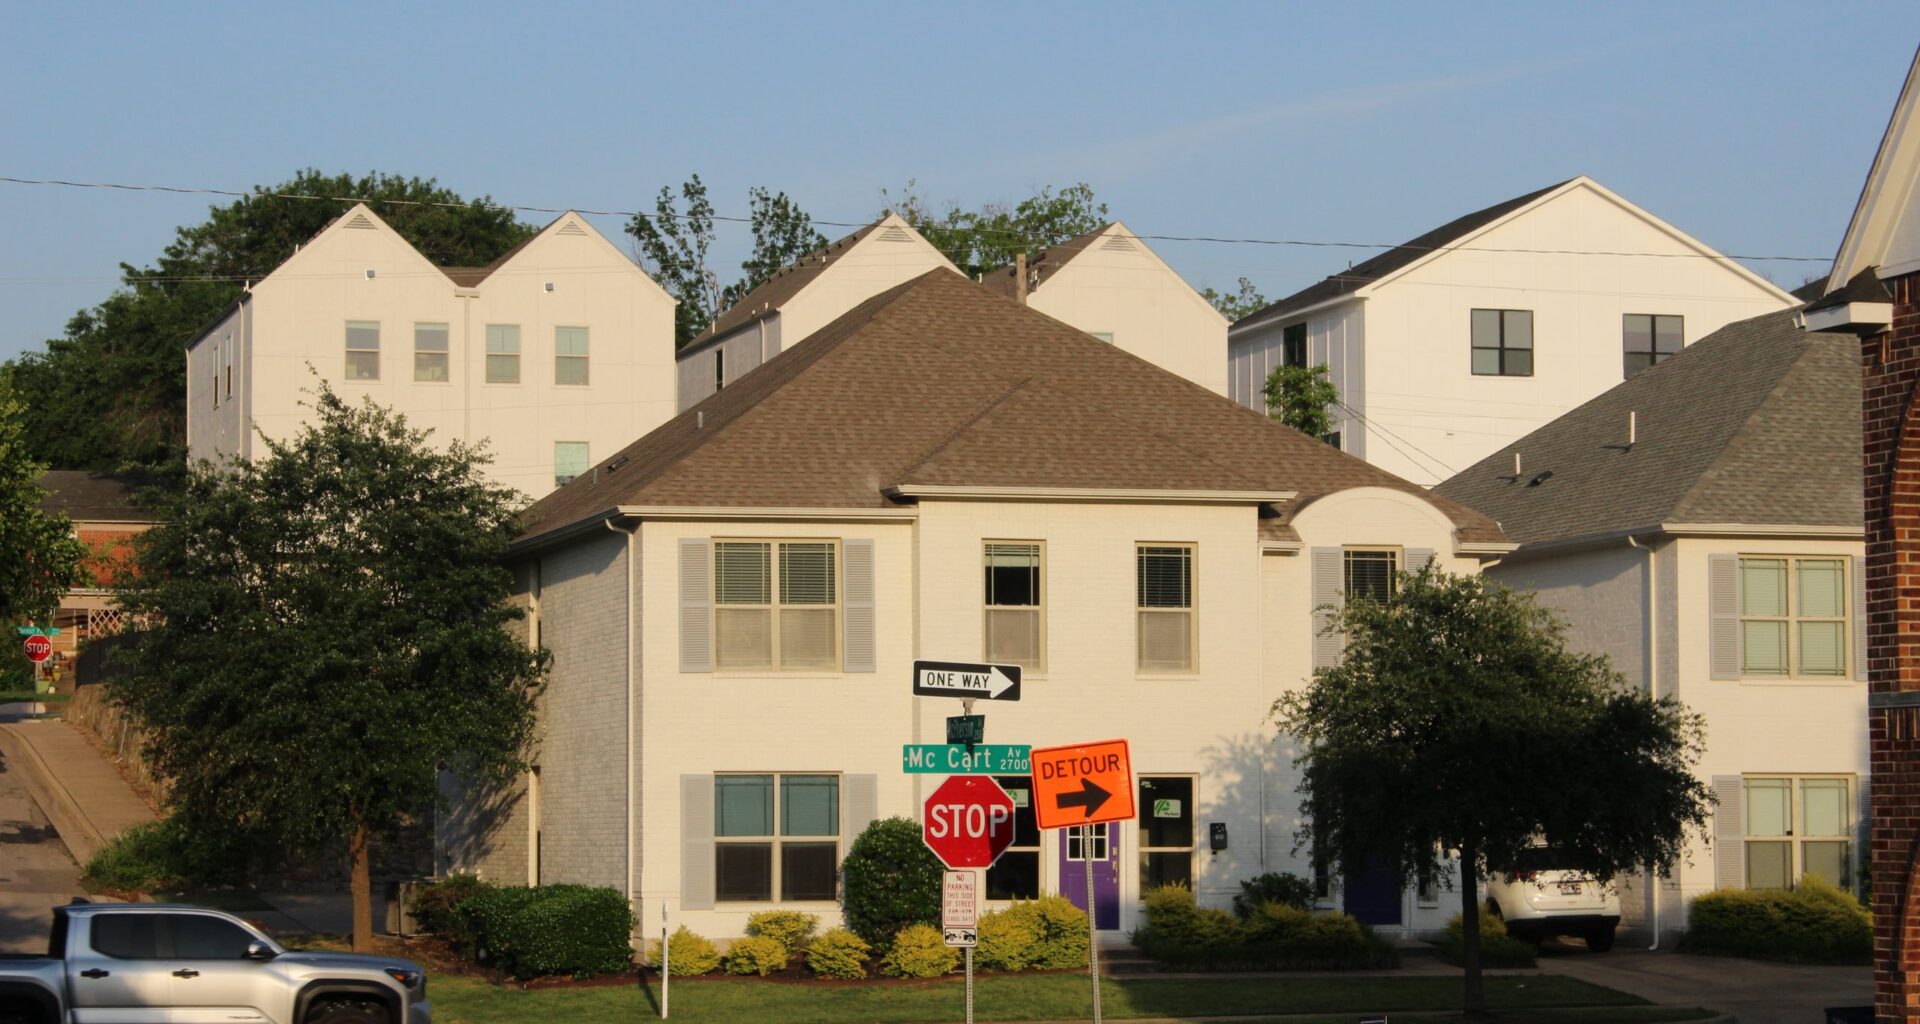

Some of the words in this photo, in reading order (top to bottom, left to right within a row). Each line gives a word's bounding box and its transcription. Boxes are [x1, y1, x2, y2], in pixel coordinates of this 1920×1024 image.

[26, 643, 50, 653] STOP
[926, 672, 955, 687] ONE
[961, 674, 990, 689] WAY
[908, 747, 936, 768] Mc
[947, 747, 991, 768] Cart
[1007, 747, 1021, 758] Av
[1000, 759, 1028, 770] 2700
[1042, 753, 1121, 780] DETOUR
[929, 803, 1009, 838] STOP
[947, 883, 973, 891] PARKING
